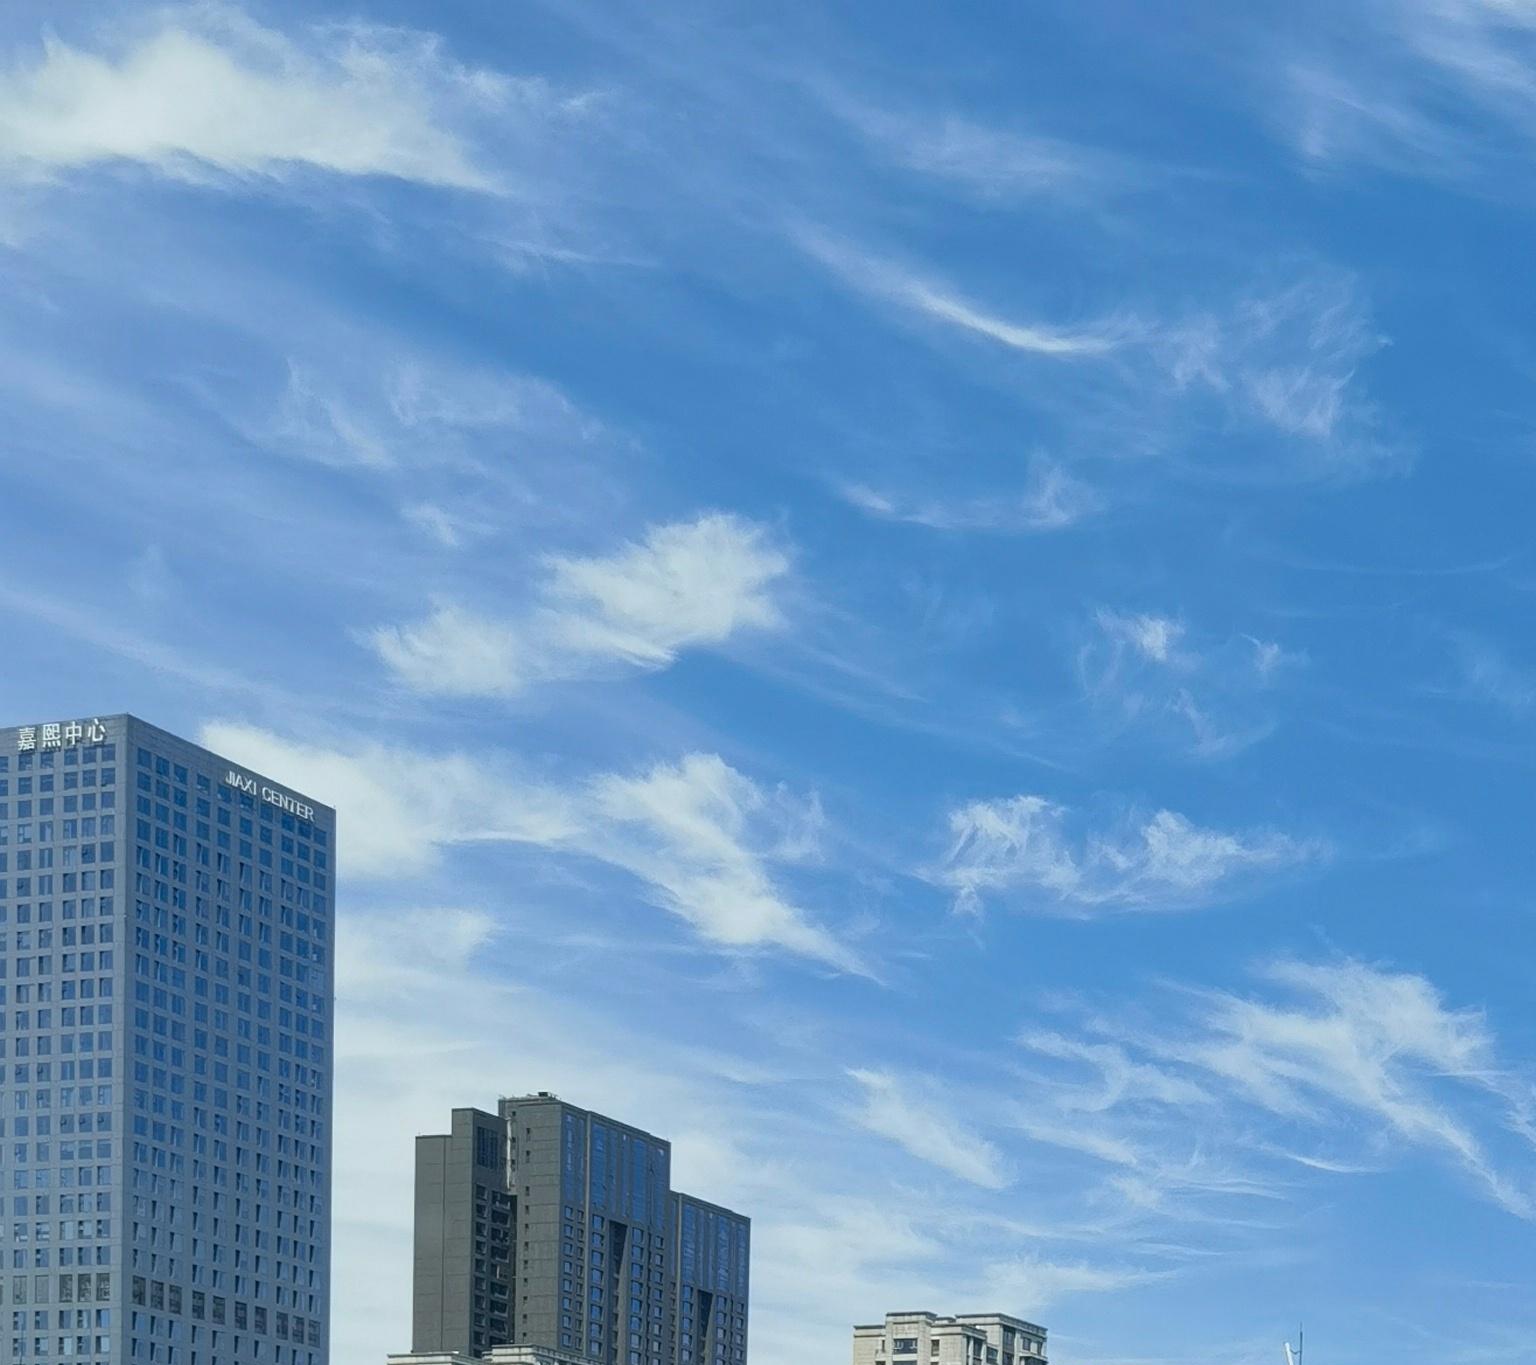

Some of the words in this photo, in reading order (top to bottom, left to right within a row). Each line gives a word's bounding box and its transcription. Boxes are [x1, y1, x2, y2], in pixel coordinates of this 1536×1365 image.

[17, 718, 106, 751] 嘉熙中心
[225, 770, 258, 796] JIAXI
[262, 786, 314, 822] CENTER
